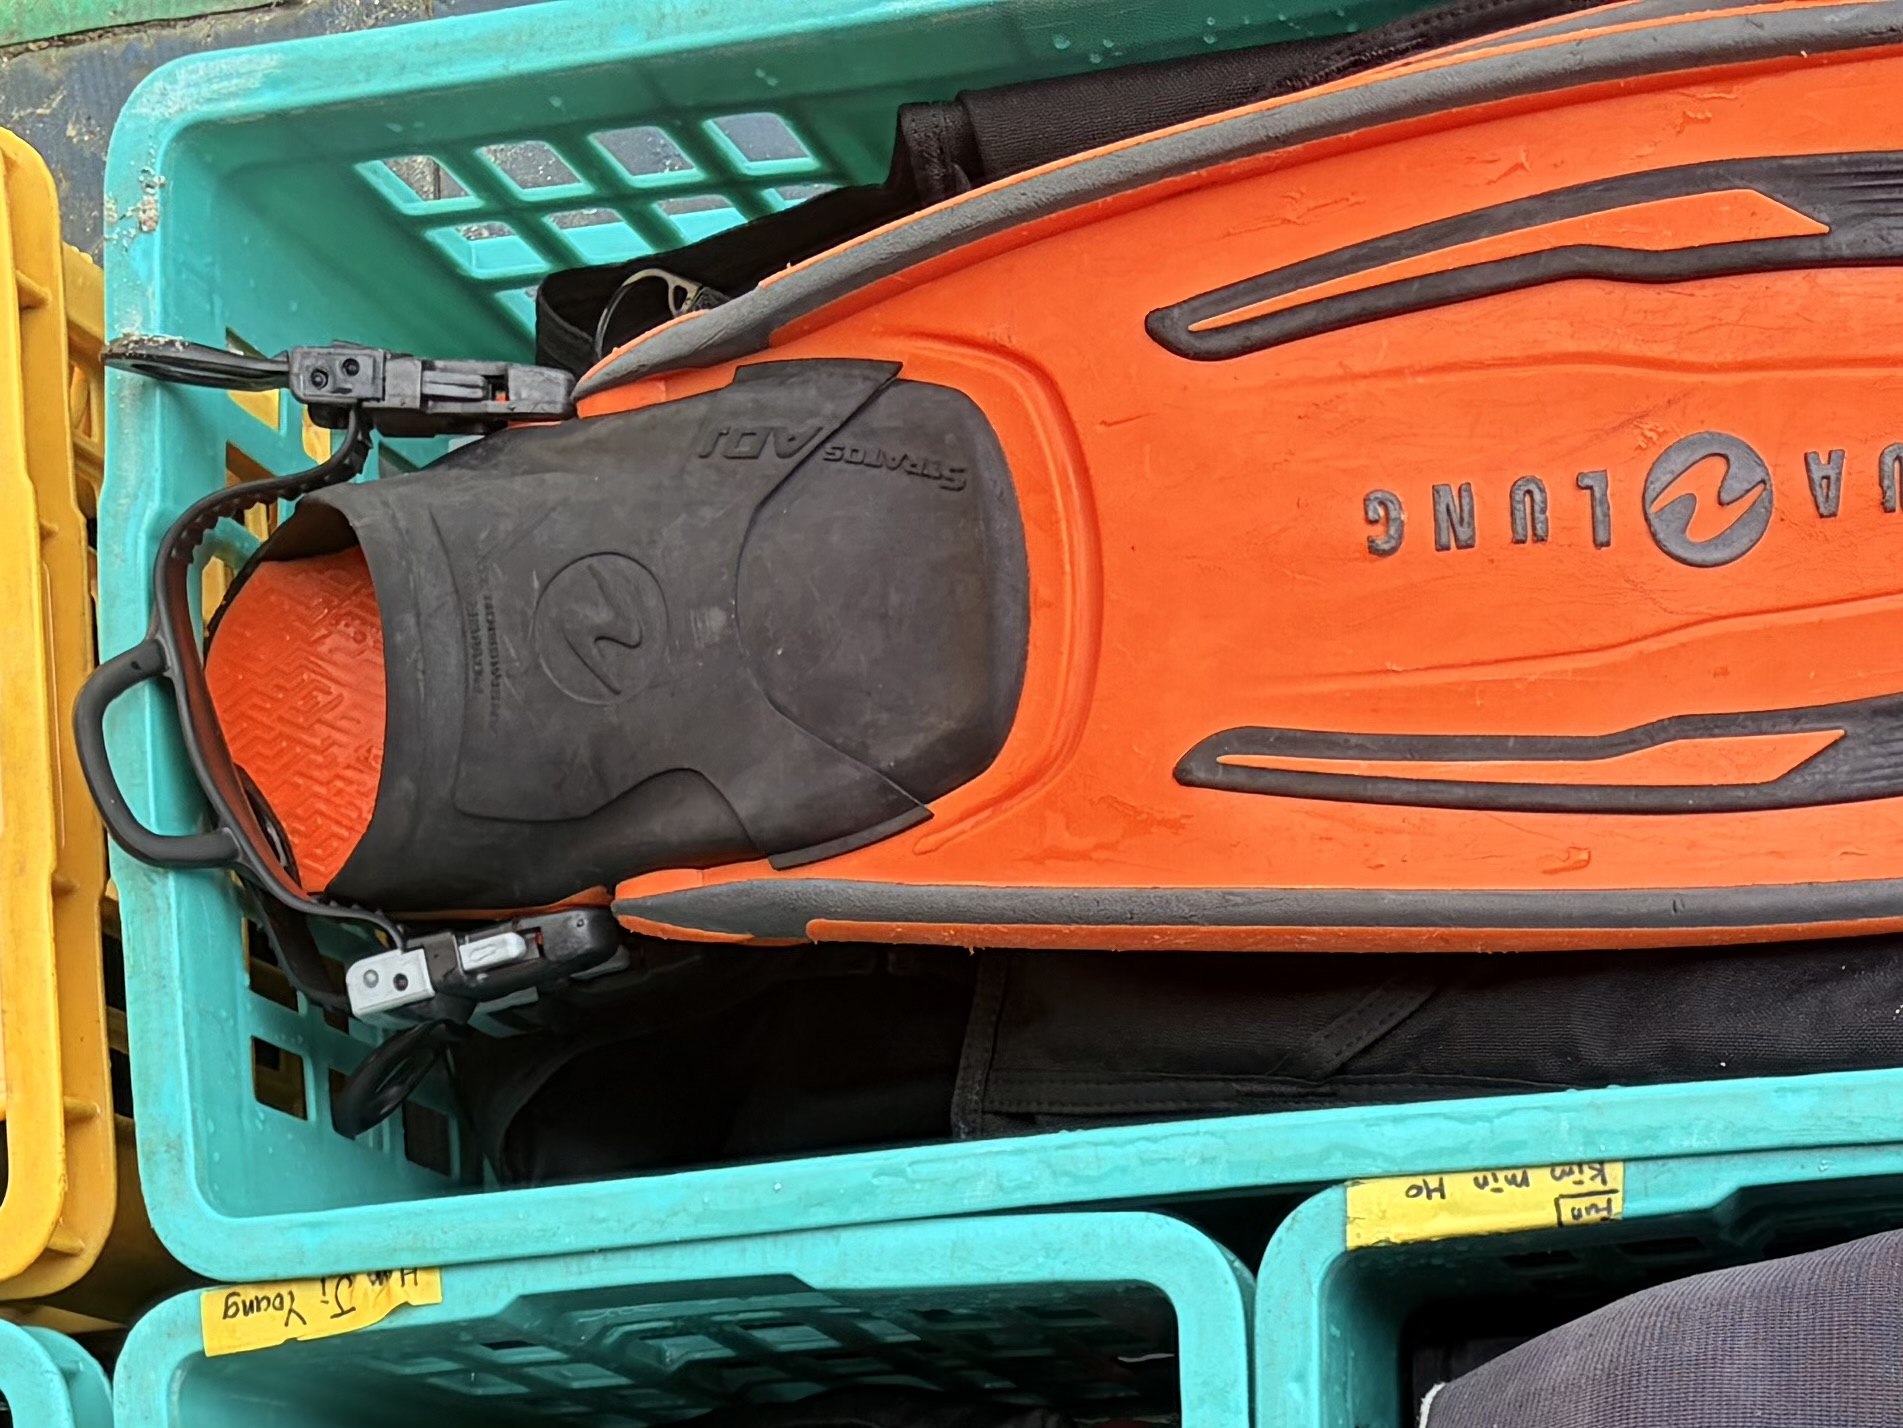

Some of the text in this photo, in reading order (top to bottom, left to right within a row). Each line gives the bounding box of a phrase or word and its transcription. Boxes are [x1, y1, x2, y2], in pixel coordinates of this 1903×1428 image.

[697, 426, 968, 493] STRATOS ADJ
[1366, 469, 1610, 556] LUNG
[222, 1291, 307, 1327] Young
